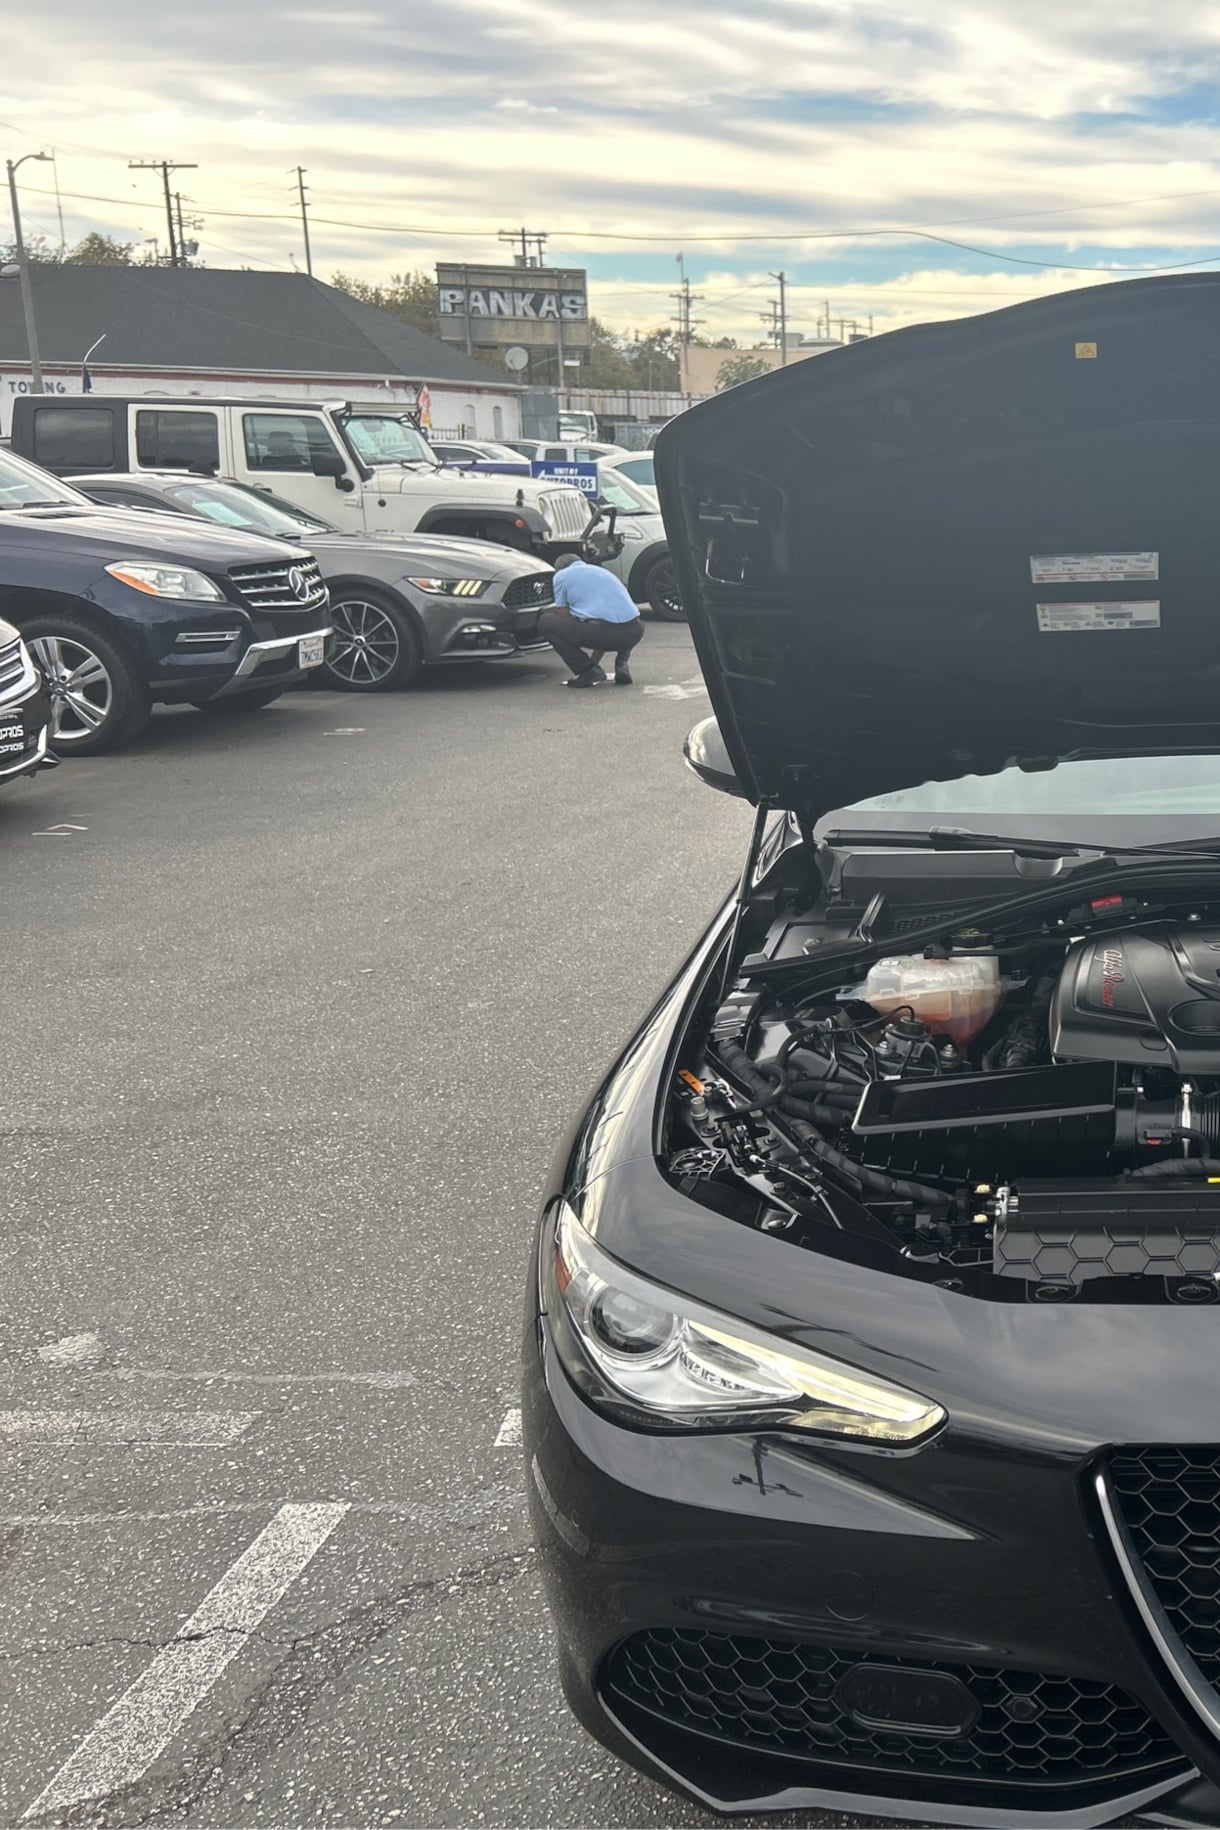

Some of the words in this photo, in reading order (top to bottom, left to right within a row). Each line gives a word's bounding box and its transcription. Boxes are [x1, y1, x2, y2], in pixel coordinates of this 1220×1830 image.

[440, 288, 586, 320] PANKAS
[8, 381, 66, 394] TONG
[0, 725, 24, 740] PROS
